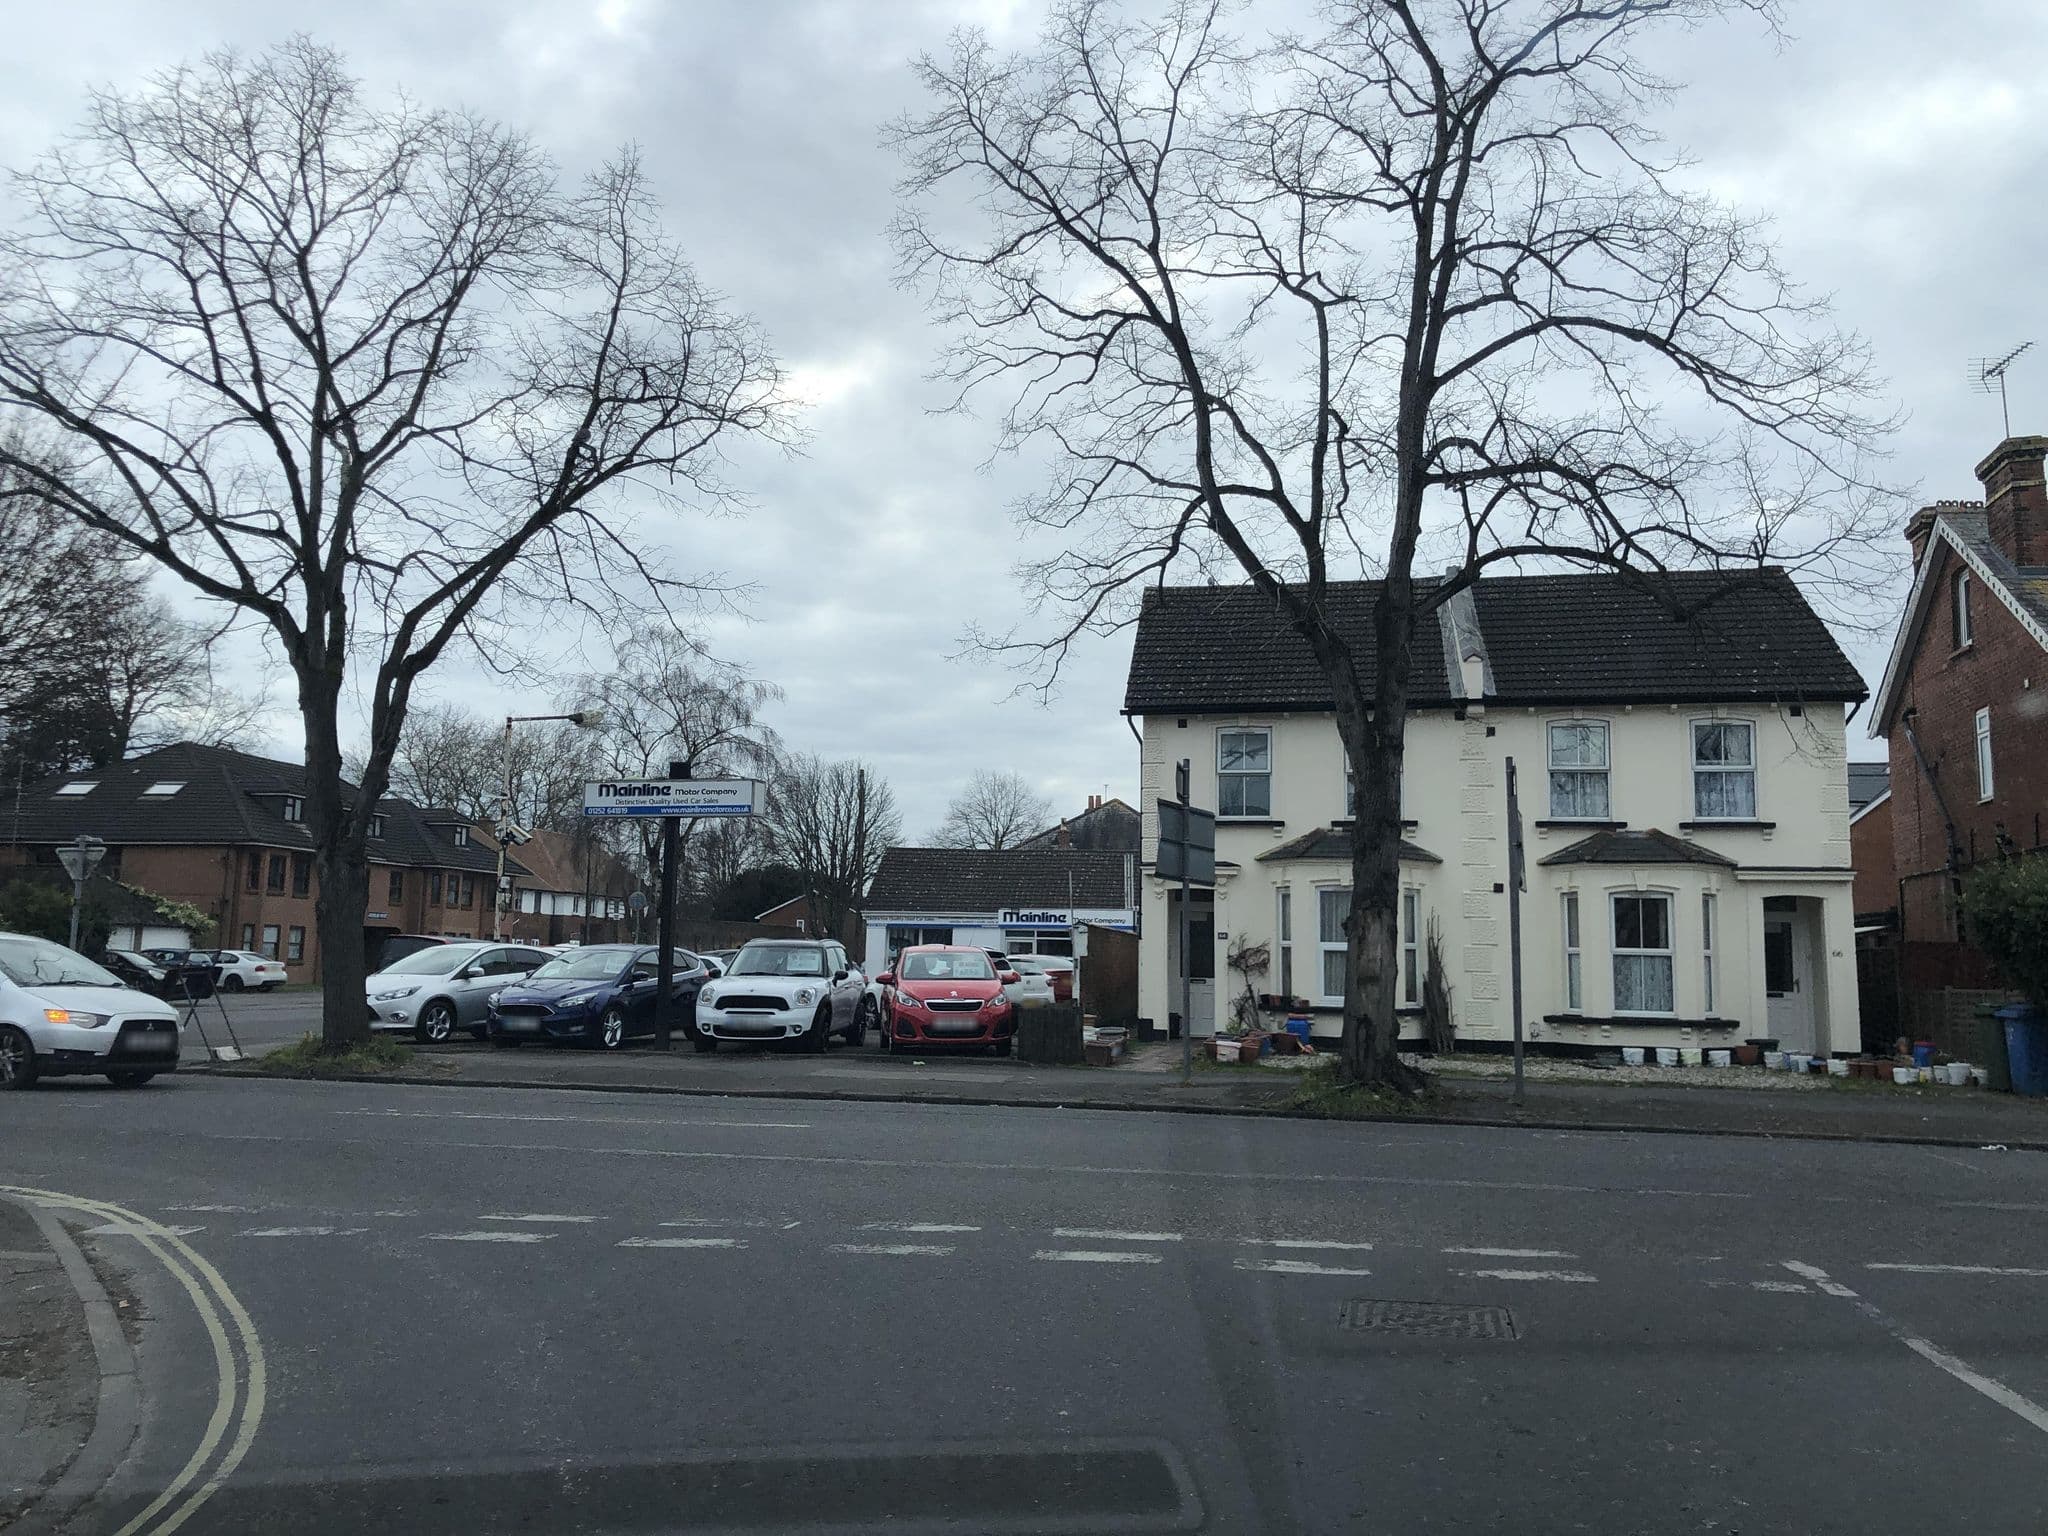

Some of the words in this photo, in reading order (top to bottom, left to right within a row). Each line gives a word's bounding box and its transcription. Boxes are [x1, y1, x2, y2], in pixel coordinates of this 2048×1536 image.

[599, 784, 671, 797] Mainline
[701, 788, 738, 797] Company
[648, 798, 671, 807] Quality
[1002, 911, 1068, 924] Mainline
[1094, 917, 1126, 926] Company
